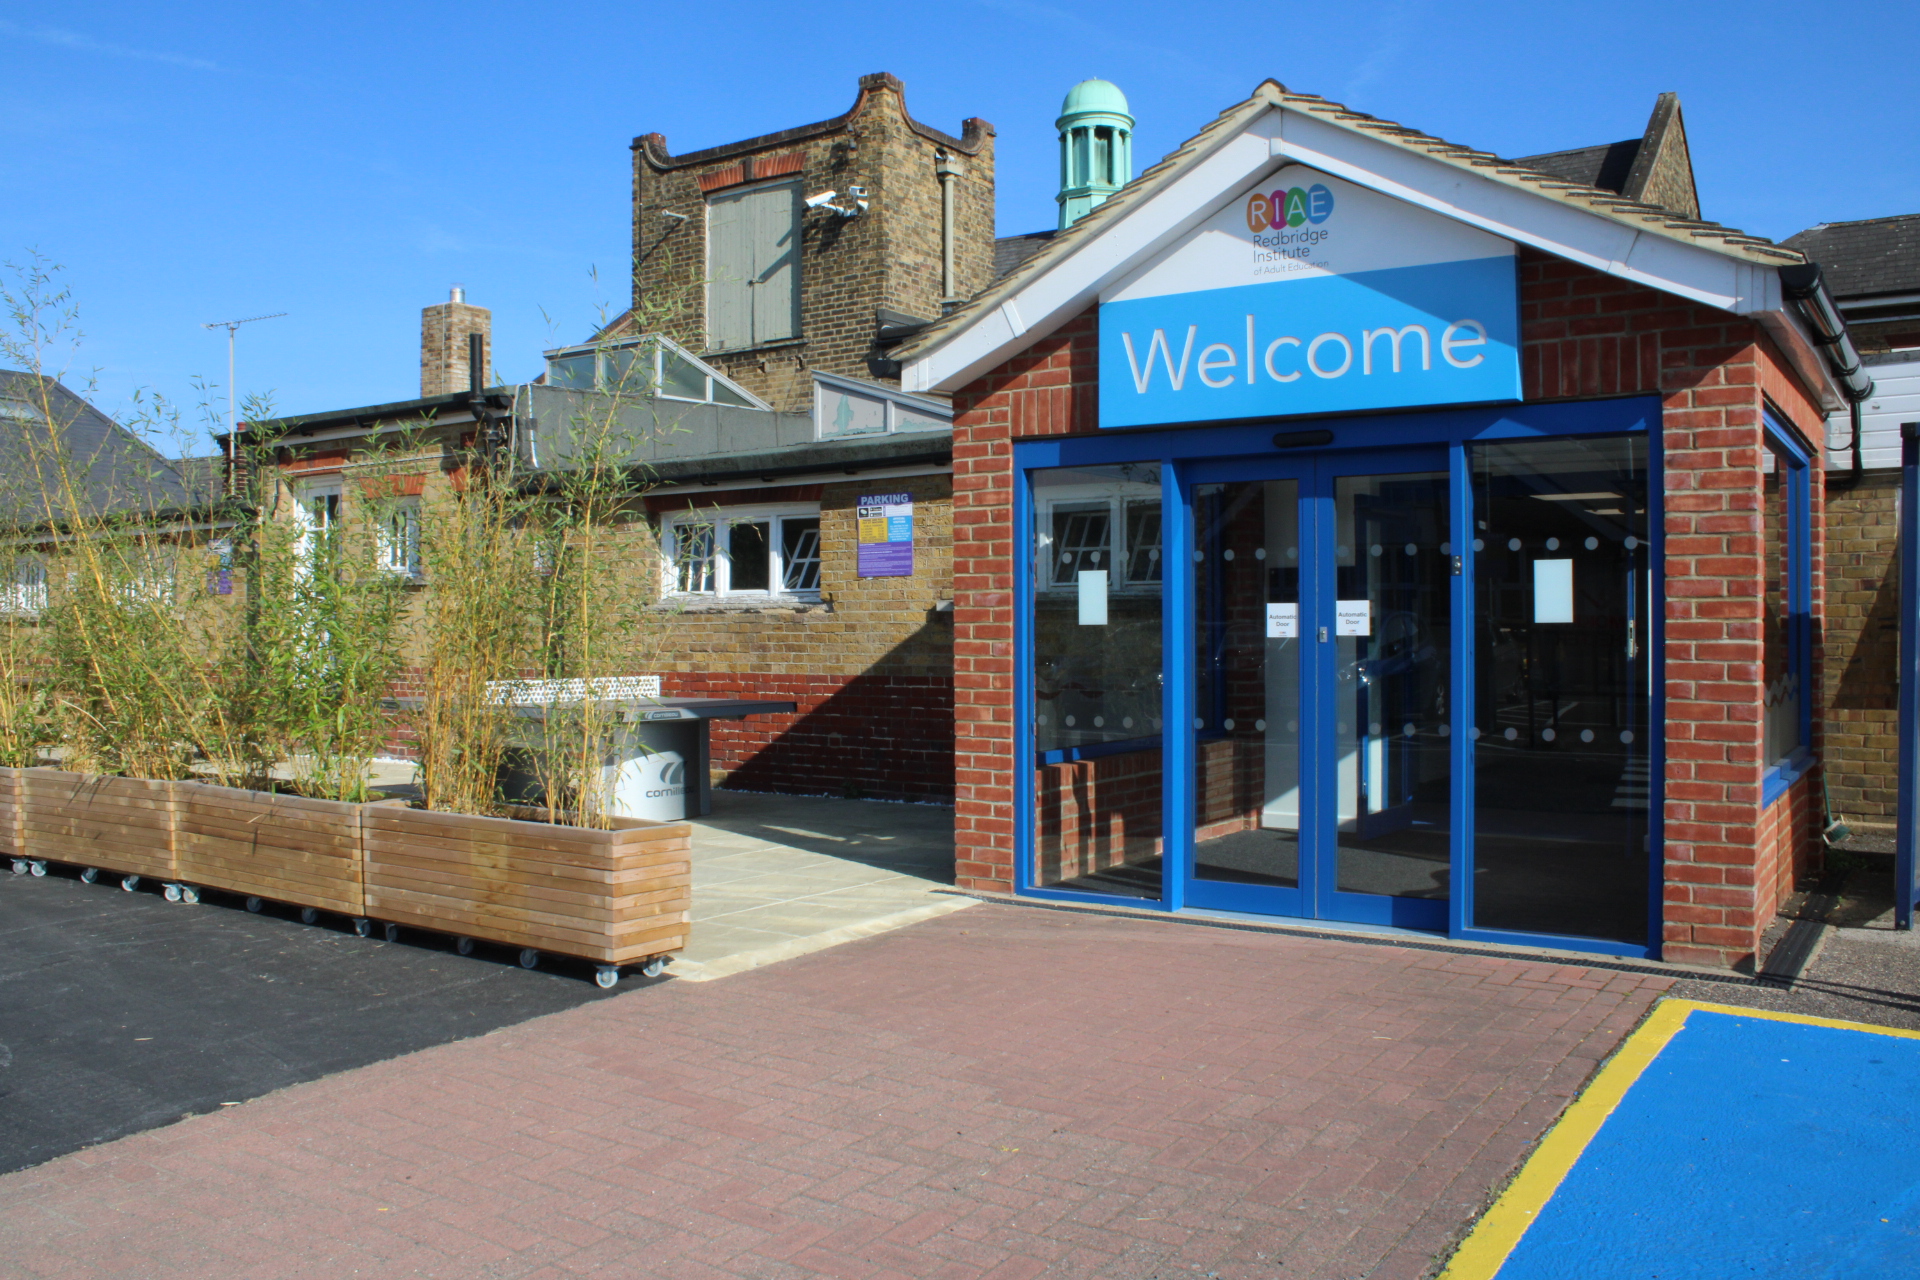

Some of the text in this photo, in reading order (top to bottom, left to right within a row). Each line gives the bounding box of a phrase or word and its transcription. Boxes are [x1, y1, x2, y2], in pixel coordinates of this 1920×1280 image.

[1251, 190, 1327, 226] RIAE
[1253, 227, 1328, 248] Redbridge
[1253, 247, 1310, 263] Institute
[1253, 260, 1329, 276] of Adult Education
[1122, 314, 1487, 394] Welcome
[860, 493, 909, 506] PARKING
